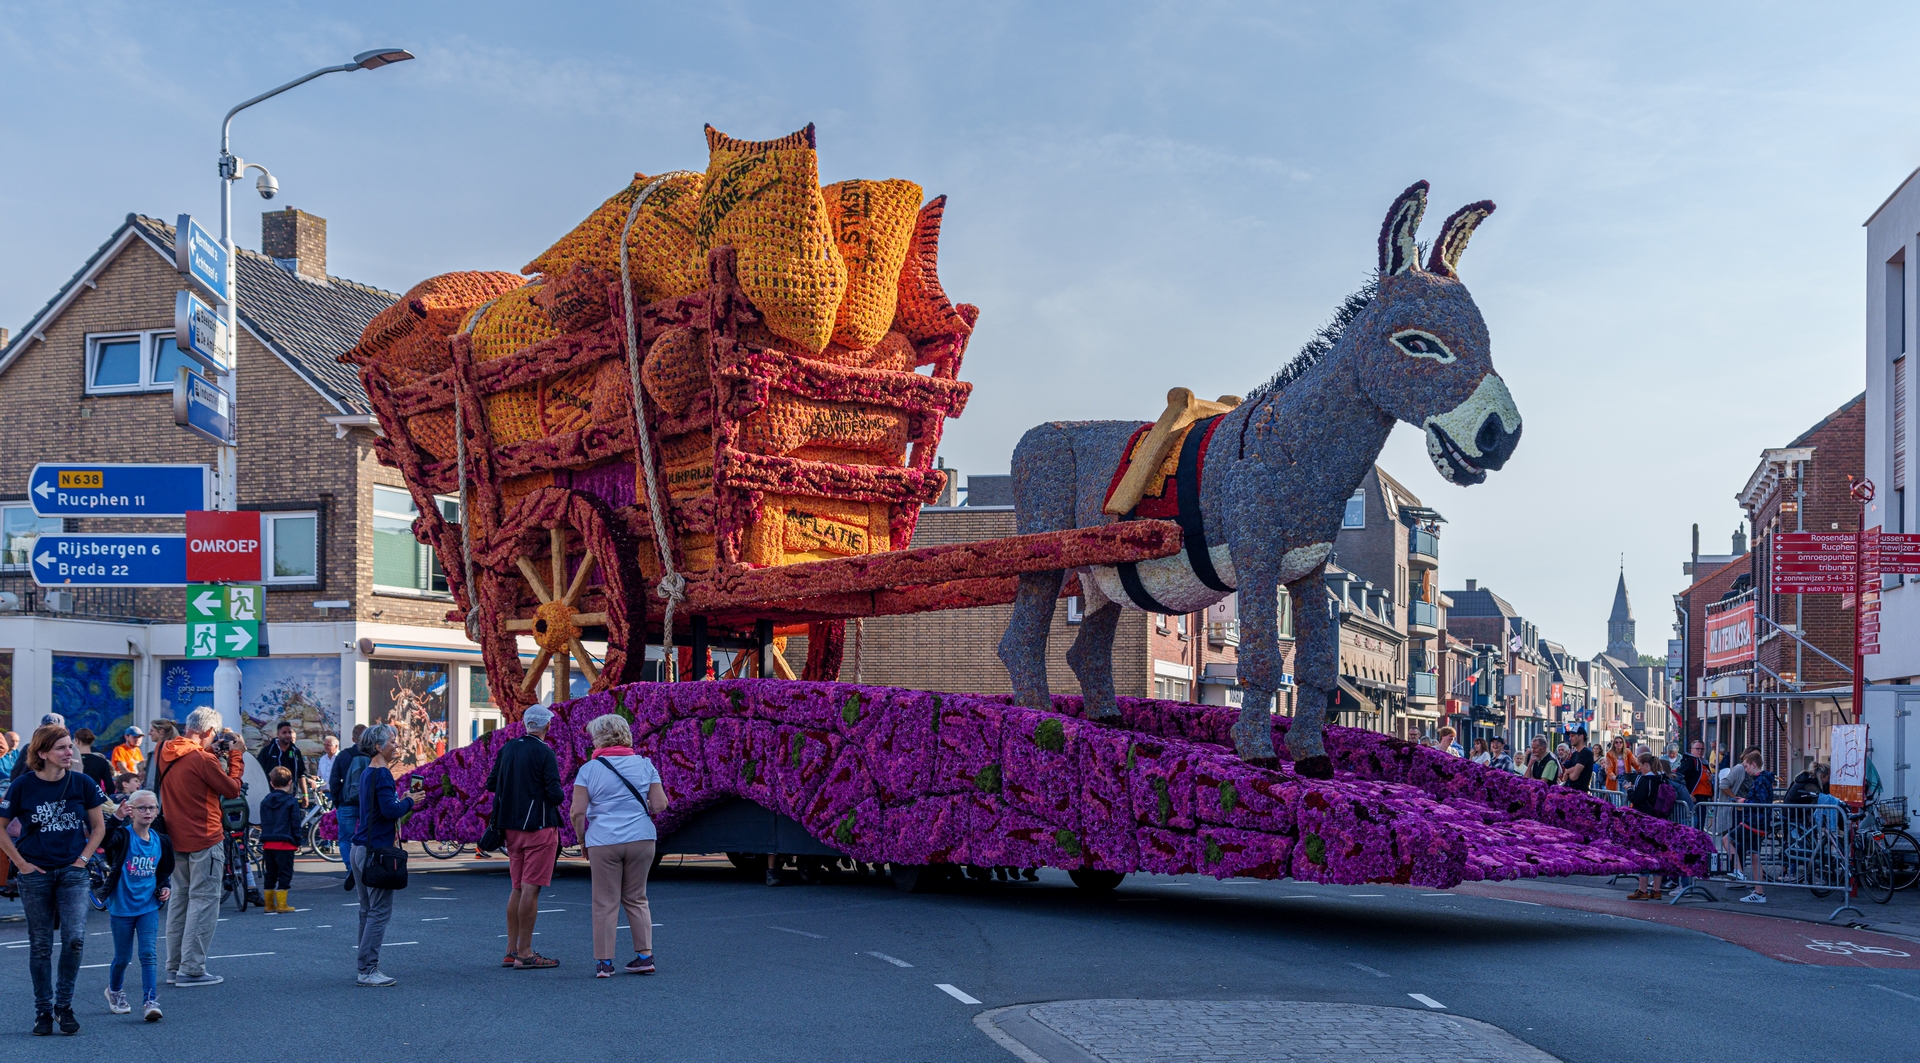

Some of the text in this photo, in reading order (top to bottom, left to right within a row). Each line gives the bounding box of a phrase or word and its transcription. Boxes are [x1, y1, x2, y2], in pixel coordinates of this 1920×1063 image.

[841, 179, 860, 244] STIKST
[62, 475, 99, 485] N 638
[58, 493, 145, 508] Rucphen 11
[787, 507, 863, 550] INFLATIE
[58, 542, 161, 558] Rijsbergen 6
[190, 539, 258, 553] OMROEP
[1881, 544, 1916, 552] newijzer
[1798, 554, 1855, 562] omroeppunten
[58, 563, 129, 576] Breda 22
[131, 855, 156, 870] POOL
[130, 869, 156, 877] PARTY
